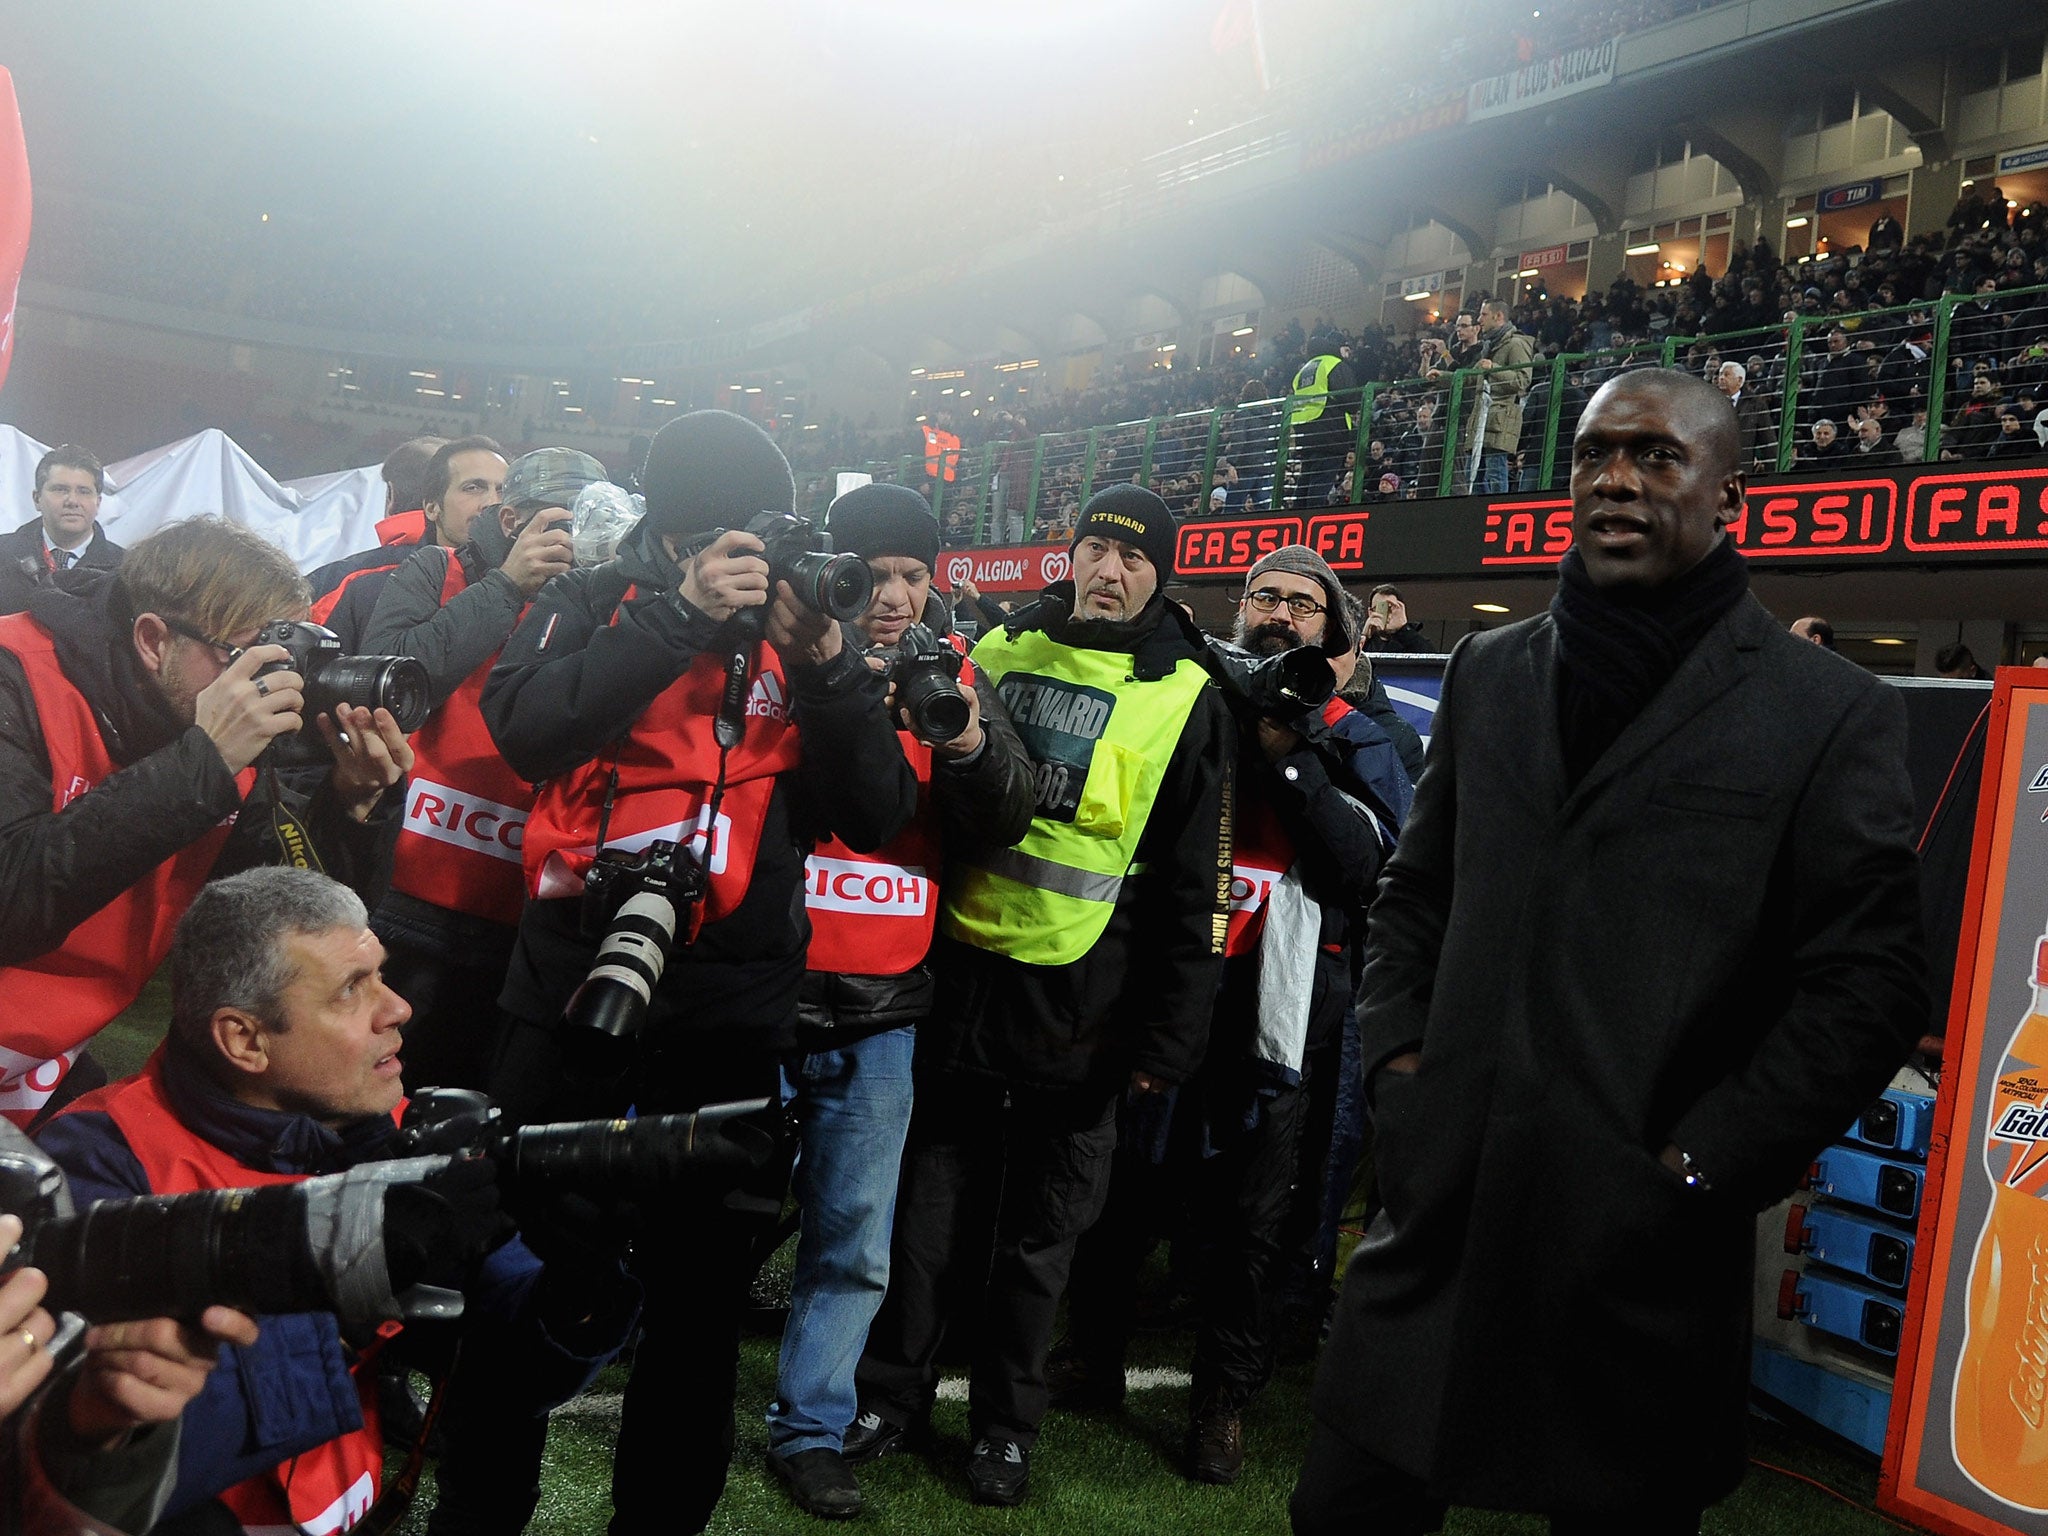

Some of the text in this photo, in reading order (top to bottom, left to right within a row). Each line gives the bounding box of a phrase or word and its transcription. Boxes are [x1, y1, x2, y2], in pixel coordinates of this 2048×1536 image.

[1516, 63, 1550, 99] CLUB
[1551, 40, 1614, 89] SALUZZO
[1847, 187, 1868, 202] TIM
[1090, 512, 1146, 534] STEWARD
[320, 639, 341, 648] Nikon
[999, 681, 1109, 740] STEWARD
[644, 876, 667, 887] Canon
[2017, 1077, 2039, 1086] SENZA
